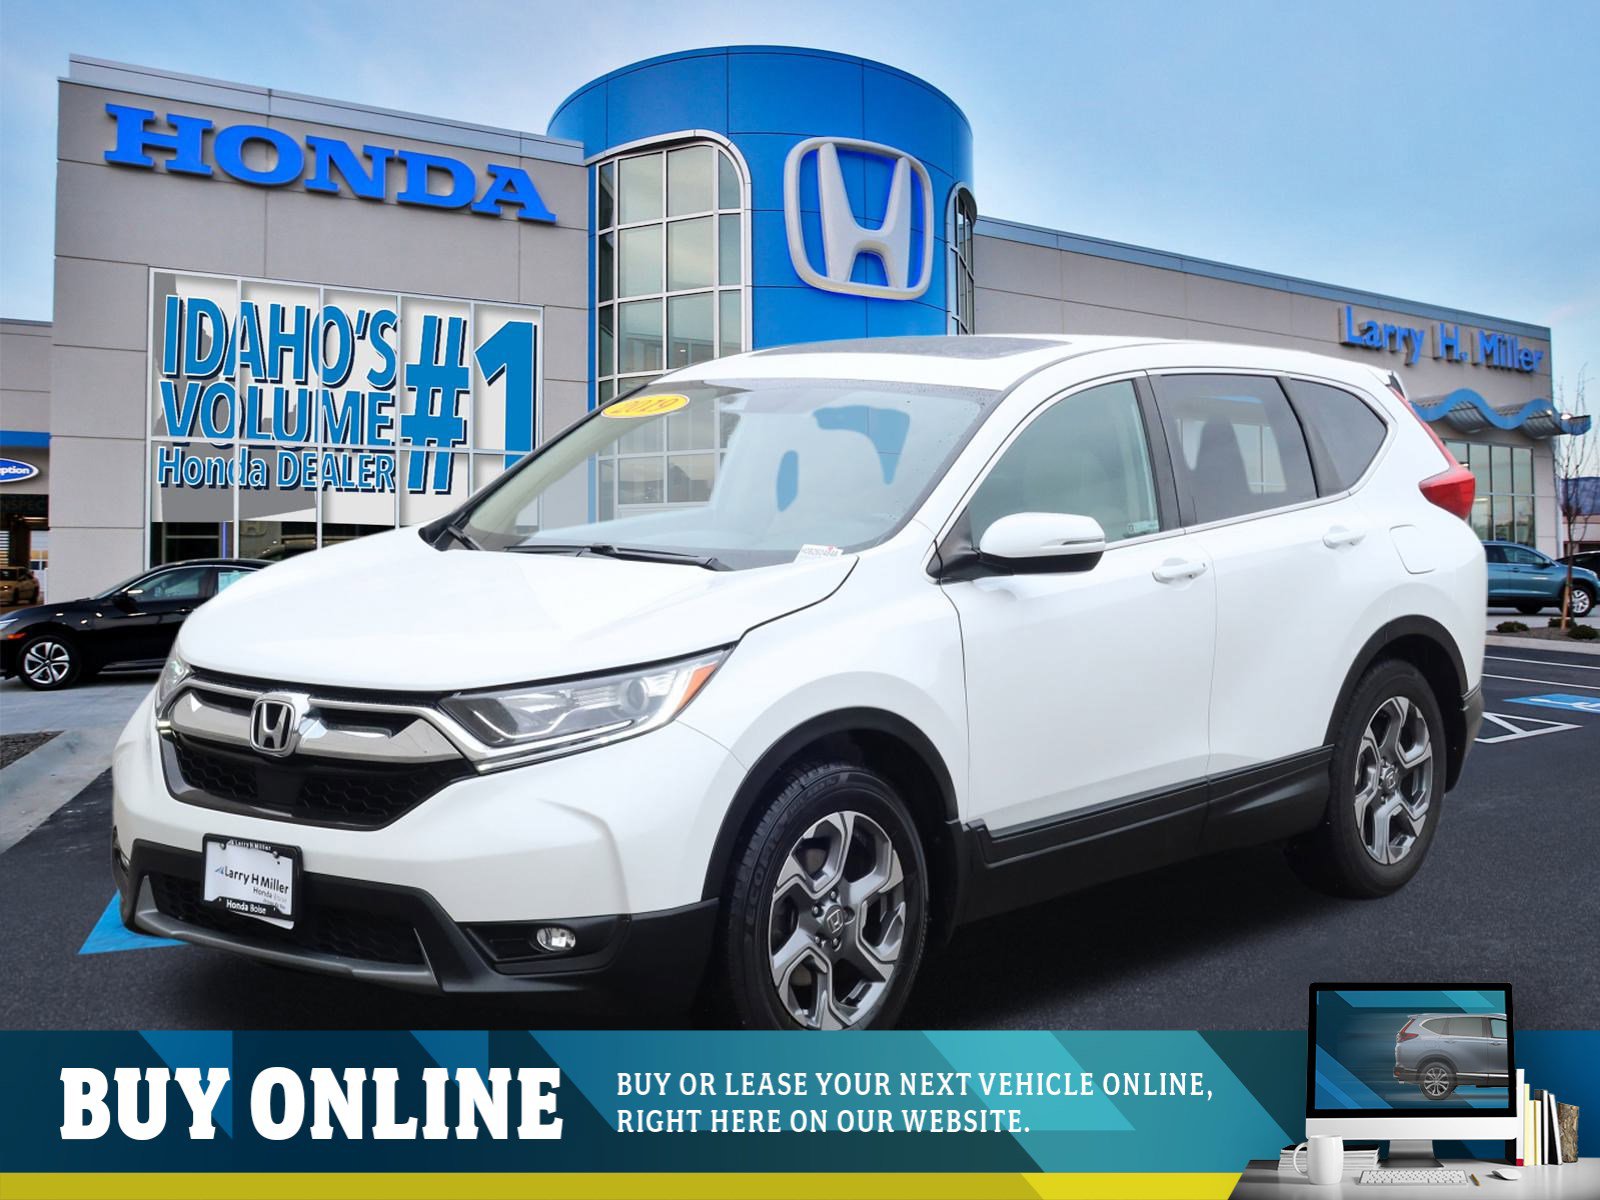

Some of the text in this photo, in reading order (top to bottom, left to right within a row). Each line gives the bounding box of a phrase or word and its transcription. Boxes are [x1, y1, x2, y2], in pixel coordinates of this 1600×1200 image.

[104, 102, 558, 224] HONDA
[162, 294, 399, 390] IDAHO'S
[1342, 305, 1545, 372] Larry H. Miller
[159, 379, 396, 453] VOLUME
[400, 314, 537, 495] #1
[157, 446, 396, 493] Honda DEALER
[224, 866, 289, 894] Larry H Miller
[226, 899, 249, 912] Honda
[253, 887, 273, 898] Honda
